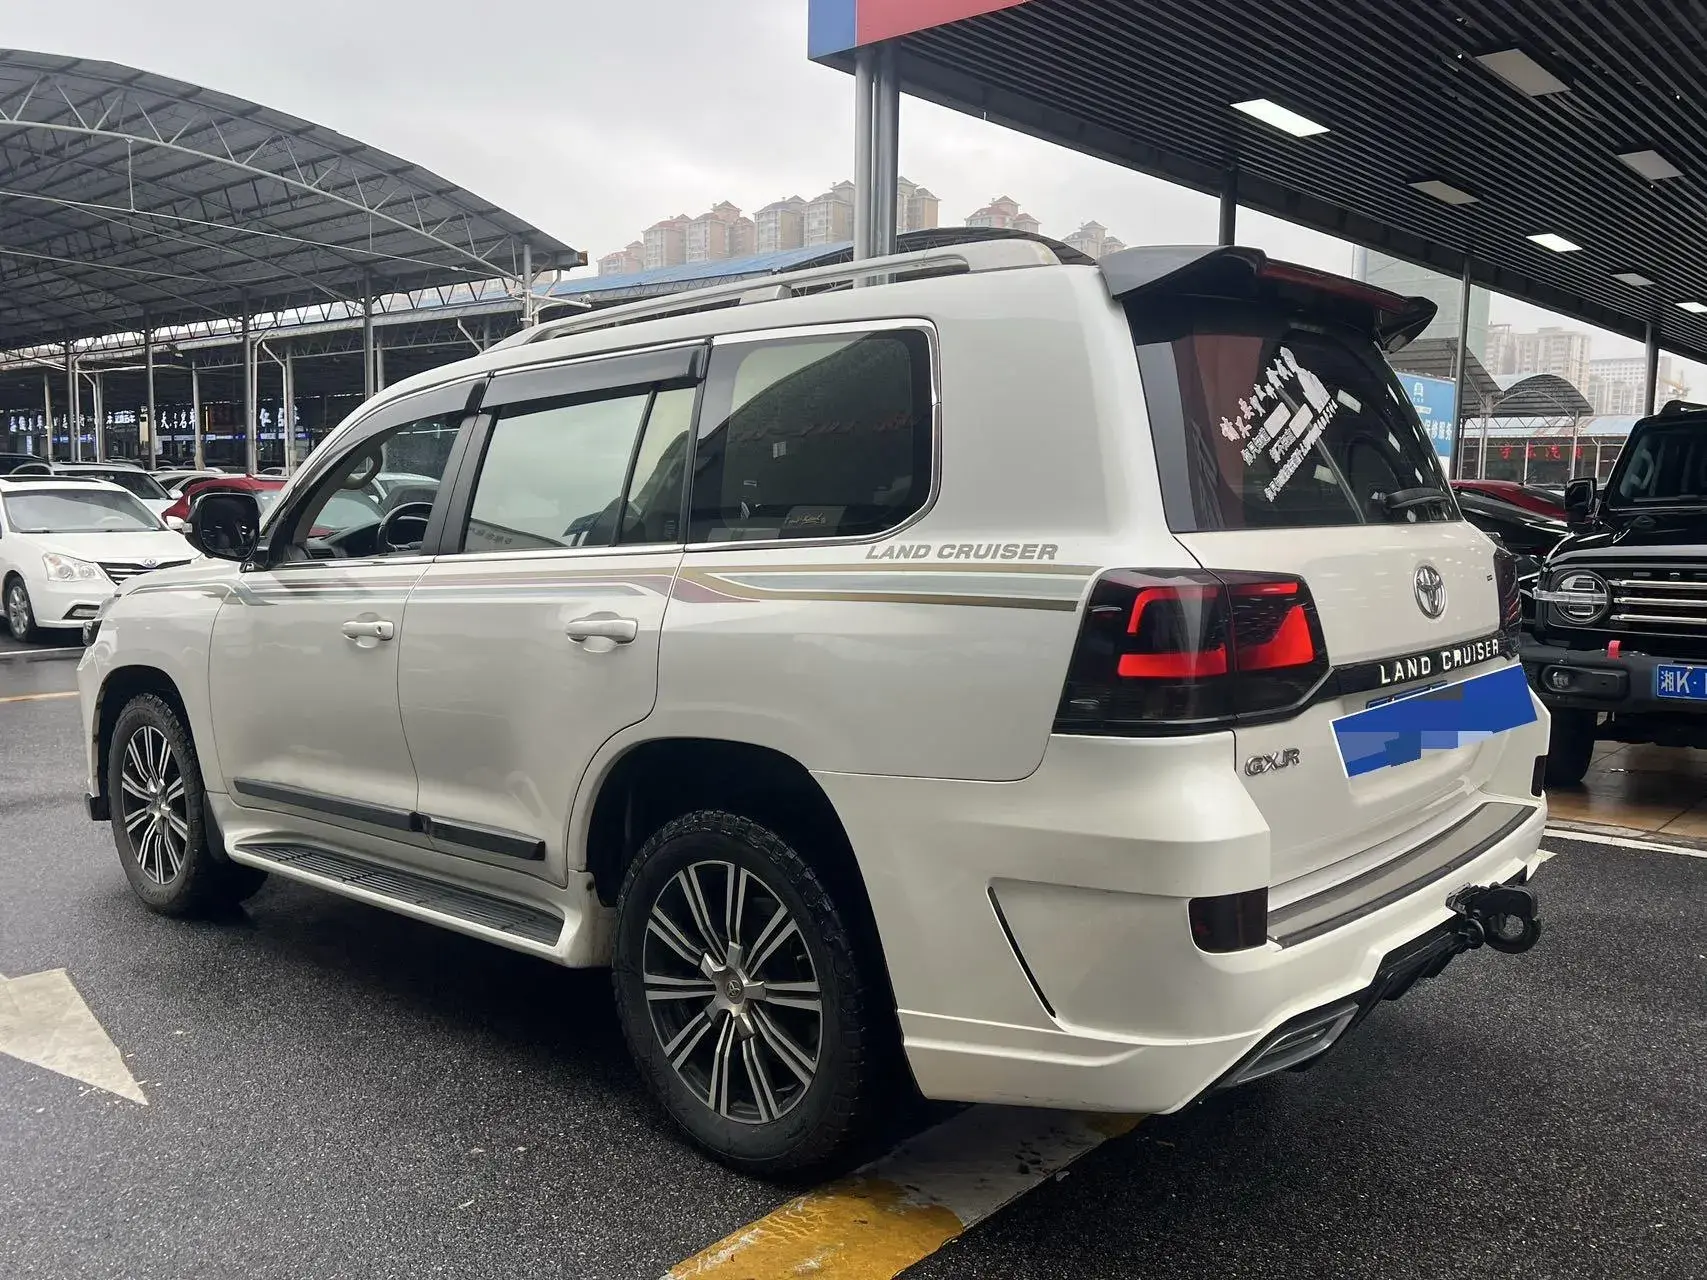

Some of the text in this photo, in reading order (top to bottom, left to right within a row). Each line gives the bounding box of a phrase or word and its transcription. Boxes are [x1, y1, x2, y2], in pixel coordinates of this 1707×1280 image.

[865, 543, 1059, 560] LAND CRUISER
[1379, 638, 1500, 684] LAND CRUISER
[1660, 670, 1707, 695] 湘K·
